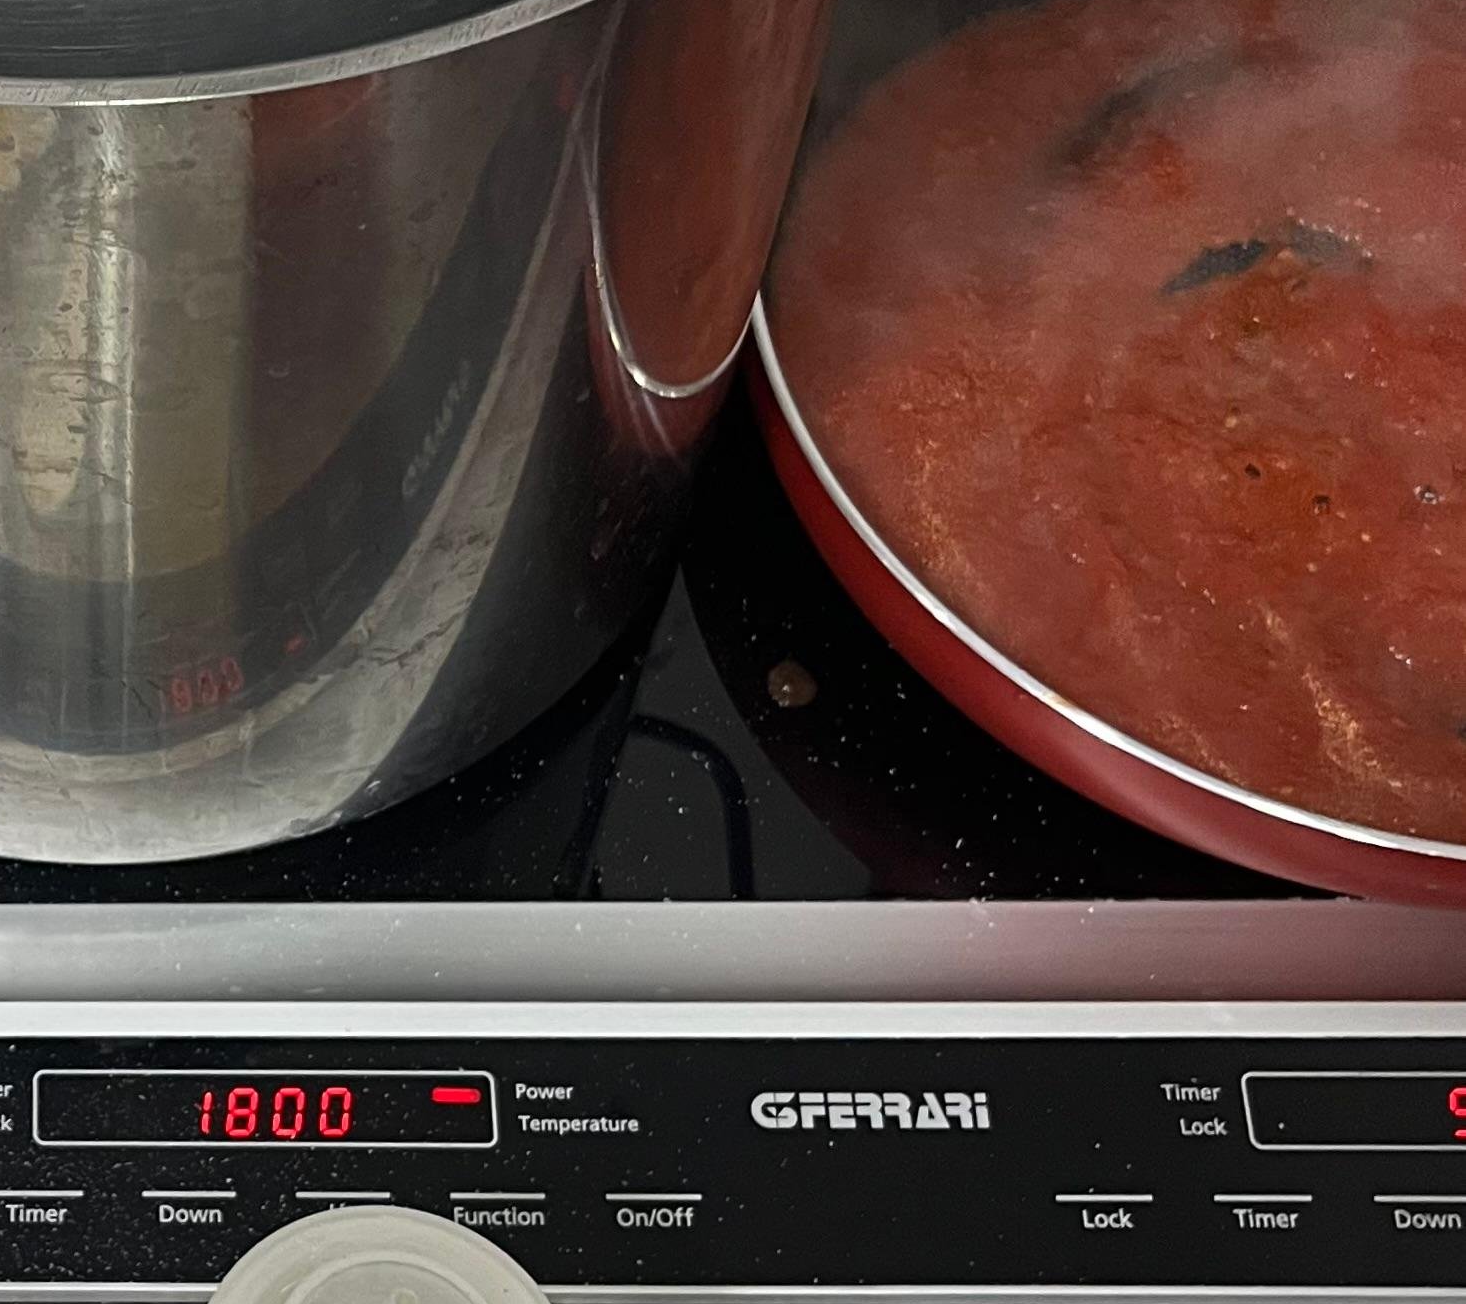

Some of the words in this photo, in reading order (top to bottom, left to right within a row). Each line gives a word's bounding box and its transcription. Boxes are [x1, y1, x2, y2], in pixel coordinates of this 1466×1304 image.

[514, 1083, 574, 1100] Power
[1159, 1083, 1221, 1101] Timer
[200, 1087, 353, 1139] 1800
[517, 1114, 639, 1137] Temperature
[1179, 1117, 1227, 1136] Lock
[5, 1203, 68, 1223] Timer
[158, 1204, 222, 1224] Down
[452, 1206, 545, 1227] Function
[615, 1206, 695, 1228] On/Off
[1082, 1207, 1134, 1229] Lock
[1232, 1208, 1300, 1229] Timer
[1394, 1209, 1463, 1229] Down
